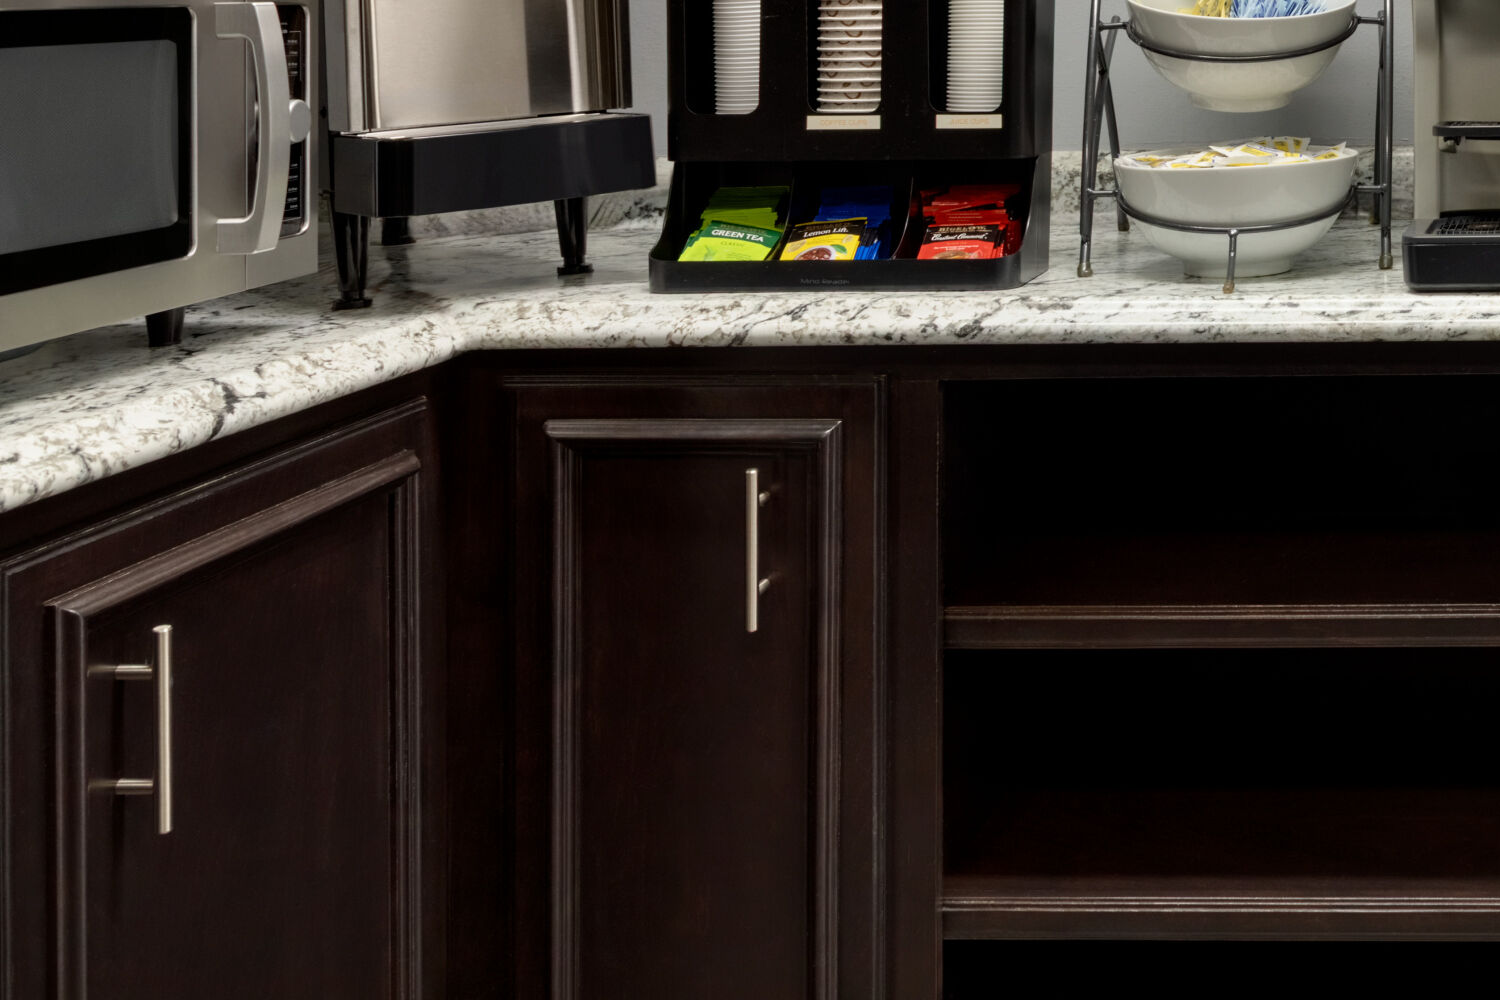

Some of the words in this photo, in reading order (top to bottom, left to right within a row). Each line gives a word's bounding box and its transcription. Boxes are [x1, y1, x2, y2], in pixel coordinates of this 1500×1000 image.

[711, 229, 744, 239] GREEN
[745, 233, 764, 243] TEA
[803, 229, 831, 239] Lemon
